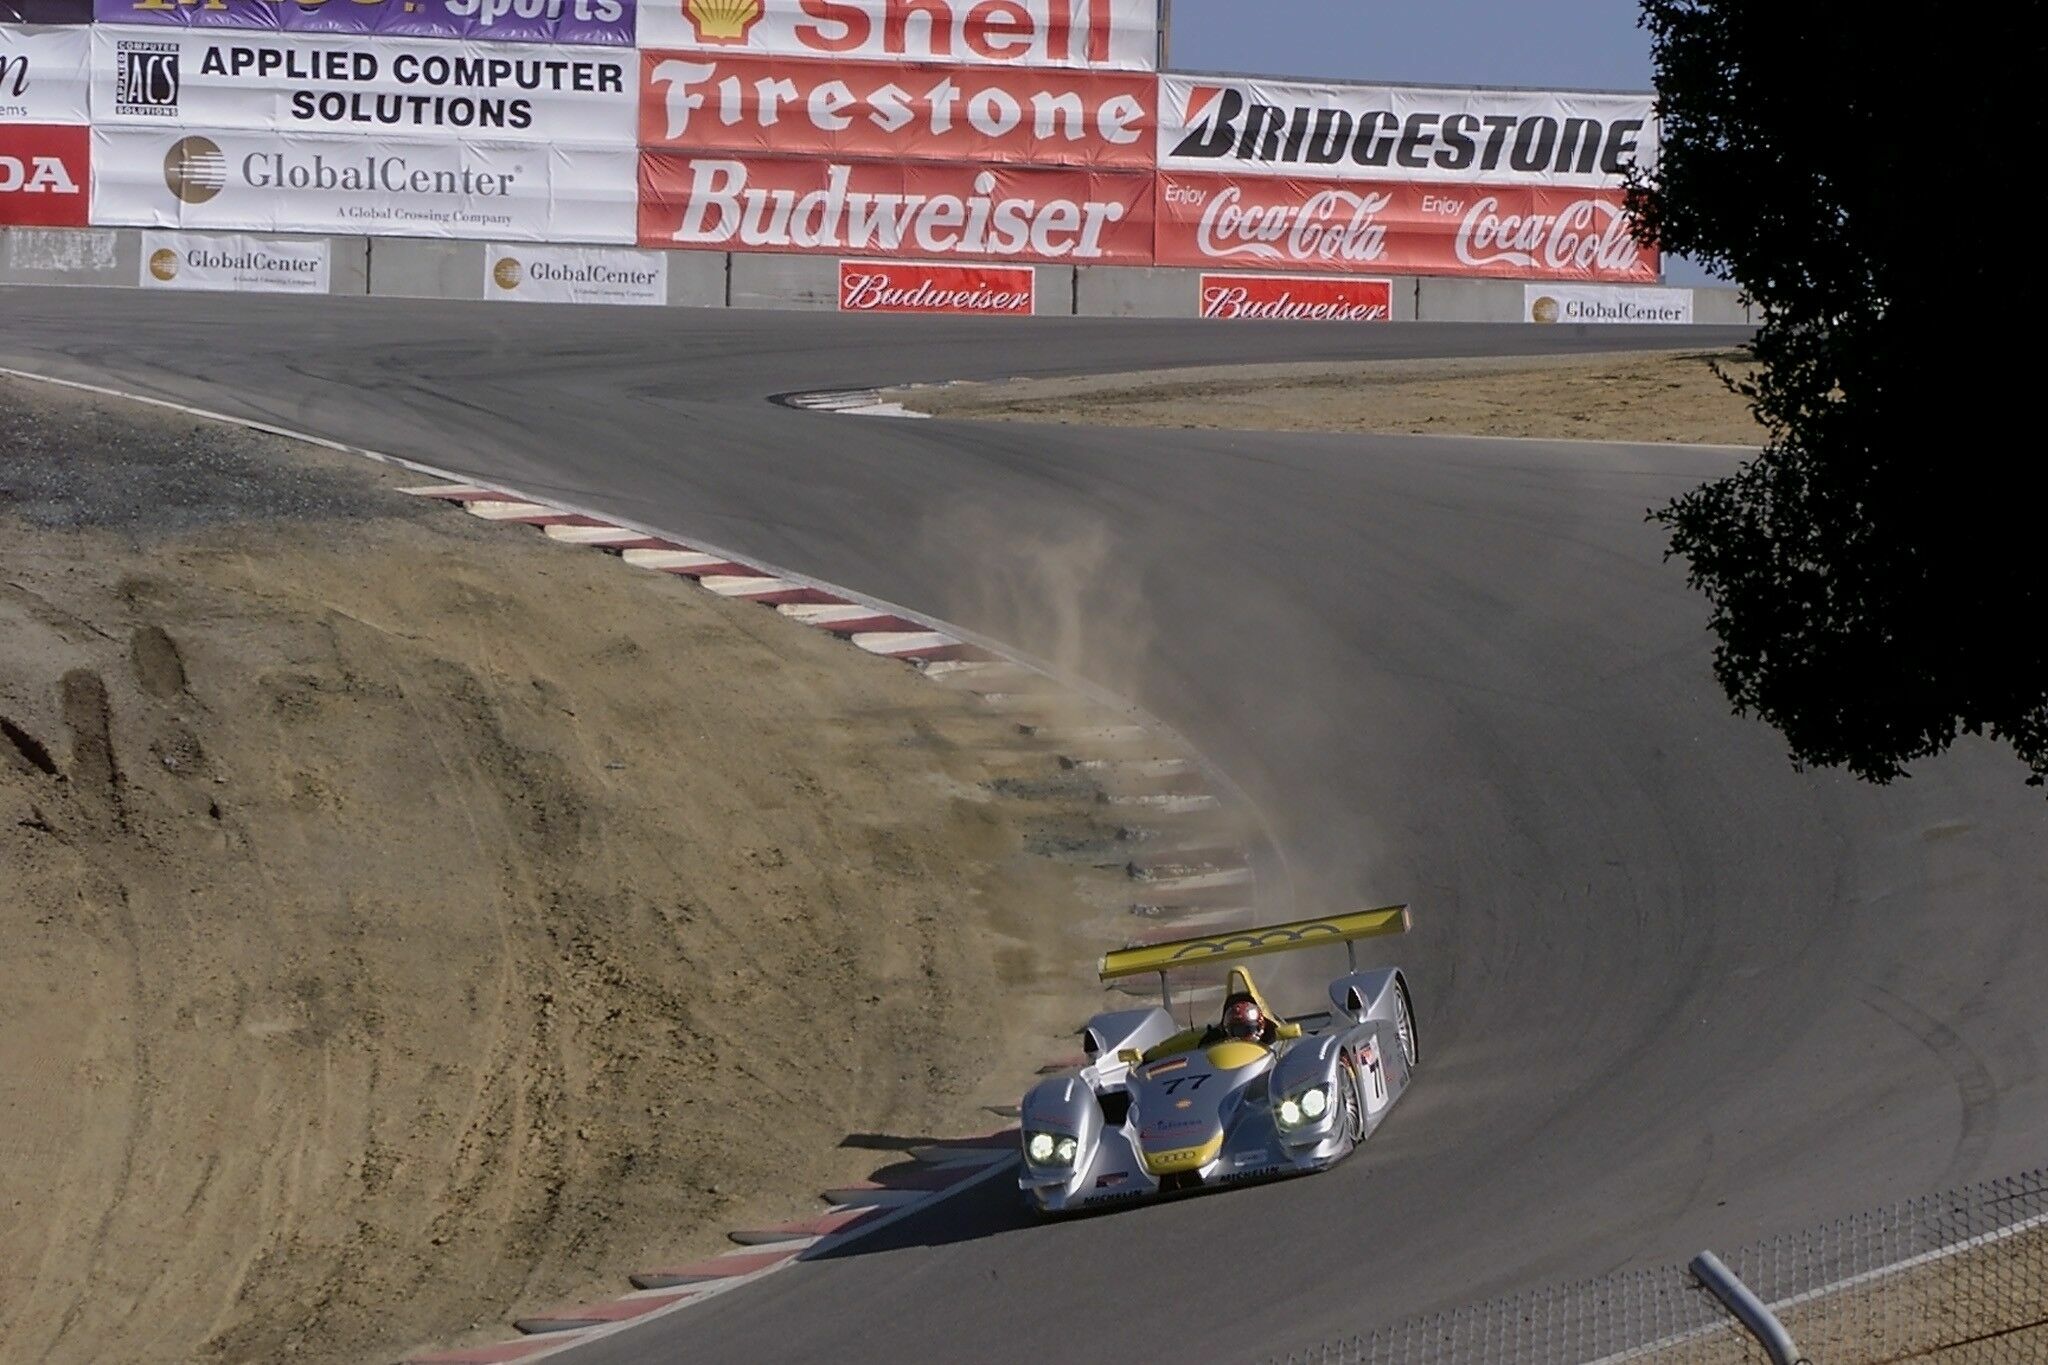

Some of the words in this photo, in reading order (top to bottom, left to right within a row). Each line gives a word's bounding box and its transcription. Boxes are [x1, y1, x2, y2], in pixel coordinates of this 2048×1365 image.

[117, 41, 180, 52] COMPUTER
[794, 0, 1111, 63] Shell
[127, 54, 176, 104] ACS
[200, 46, 378, 82] APPLIED
[393, 54, 623, 93] COMPUTER
[115, 106, 179, 117] SOLUTIONS
[292, 90, 532, 129] SOLUTIONS
[651, 60, 1146, 144] Firestone
[1169, 87, 1644, 175] BRIDGESTONE
[241, 151, 515, 197] GlobalCenter
[336, 206, 346, 218] A
[349, 206, 392, 220] Global
[394, 208, 450, 223] Crossing
[452, 211, 512, 227] Company
[673, 159, 1123, 258] Budweiser
[1164, 184, 1207, 206] Enjoy
[1197, 186, 1393, 262] Coca-Cola
[1421, 195, 1464, 217] Enjoy
[1454, 196, 1641, 271] Coca-Cola
[187, 249, 319, 274] GlobalCenter
[530, 261, 657, 286] GlobalCenter
[843, 273, 1030, 310] Budweiser
[1203, 286, 1388, 321] Budweiser
[1565, 300, 1683, 321] GlobalCenter
[1161, 1073, 1212, 1096] 77
